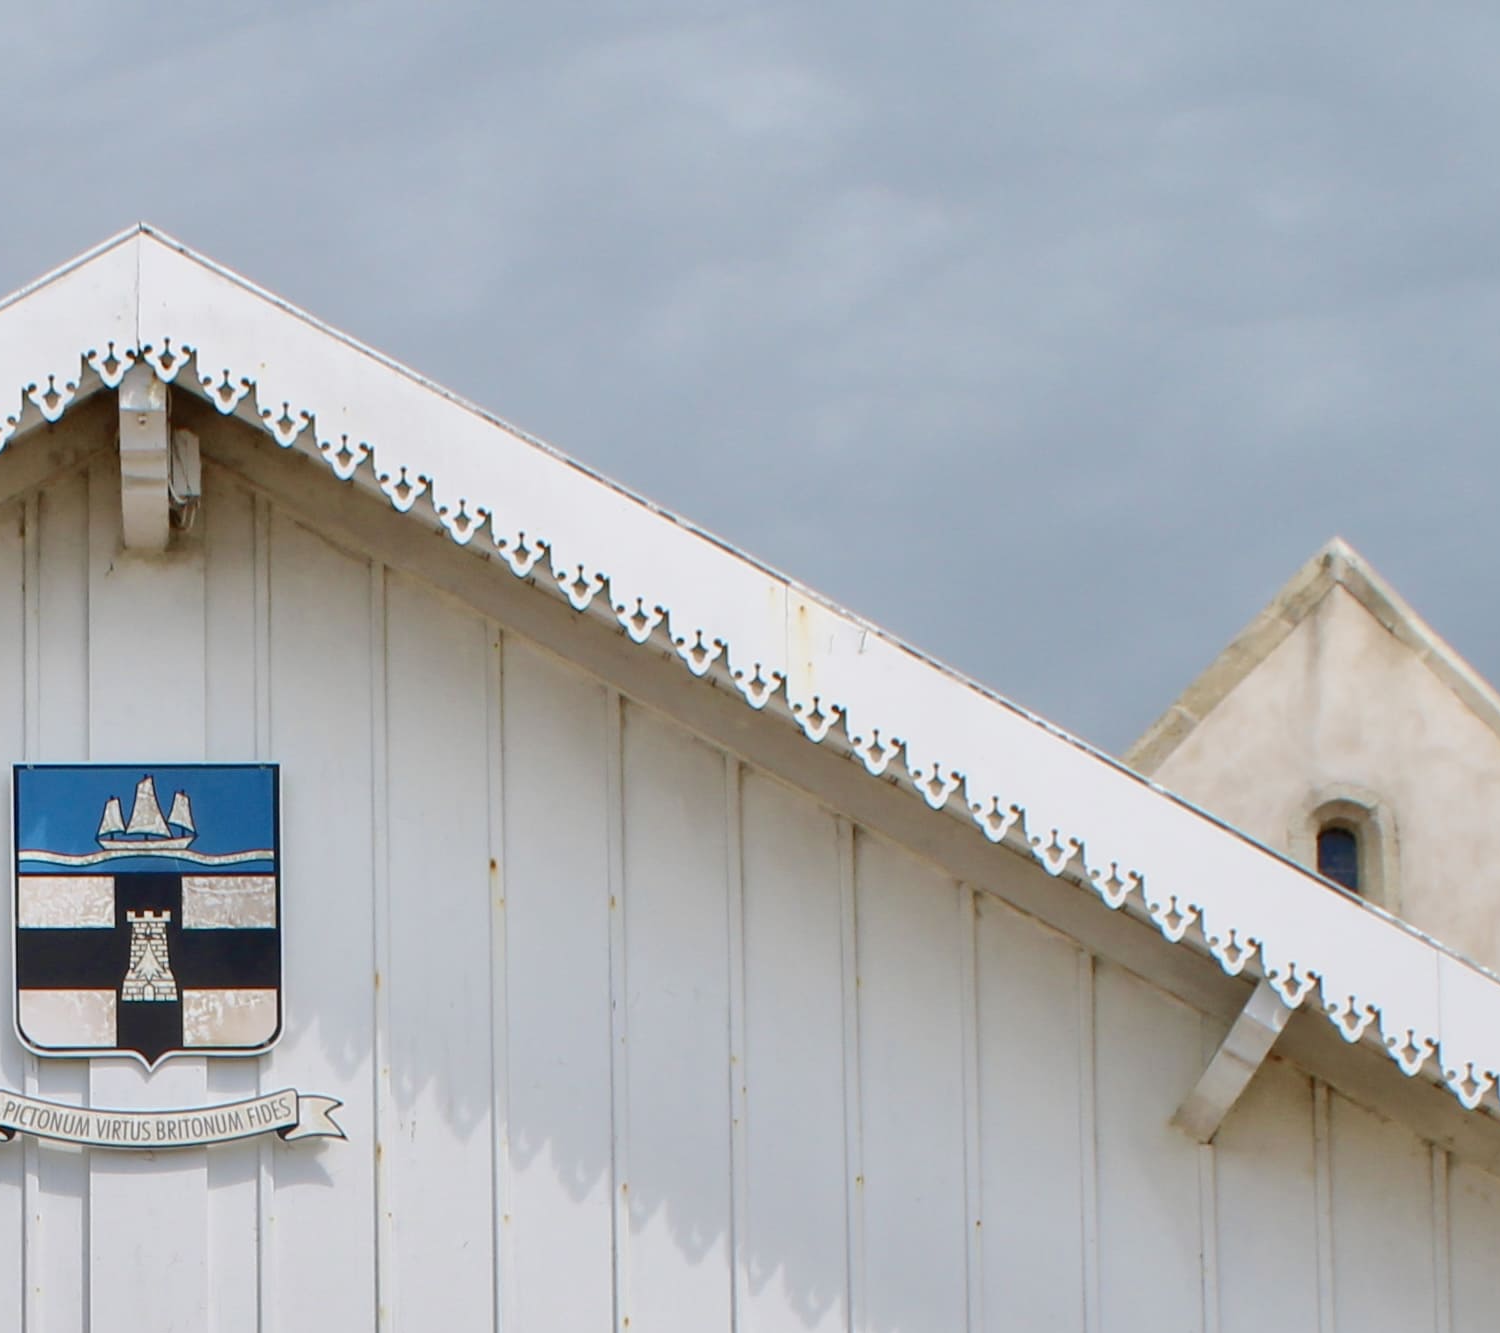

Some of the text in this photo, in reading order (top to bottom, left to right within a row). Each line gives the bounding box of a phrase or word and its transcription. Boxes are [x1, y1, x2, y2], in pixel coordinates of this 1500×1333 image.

[1, 1096, 293, 1142] PICTONUM VIRTUS BRITONUM FIDES
